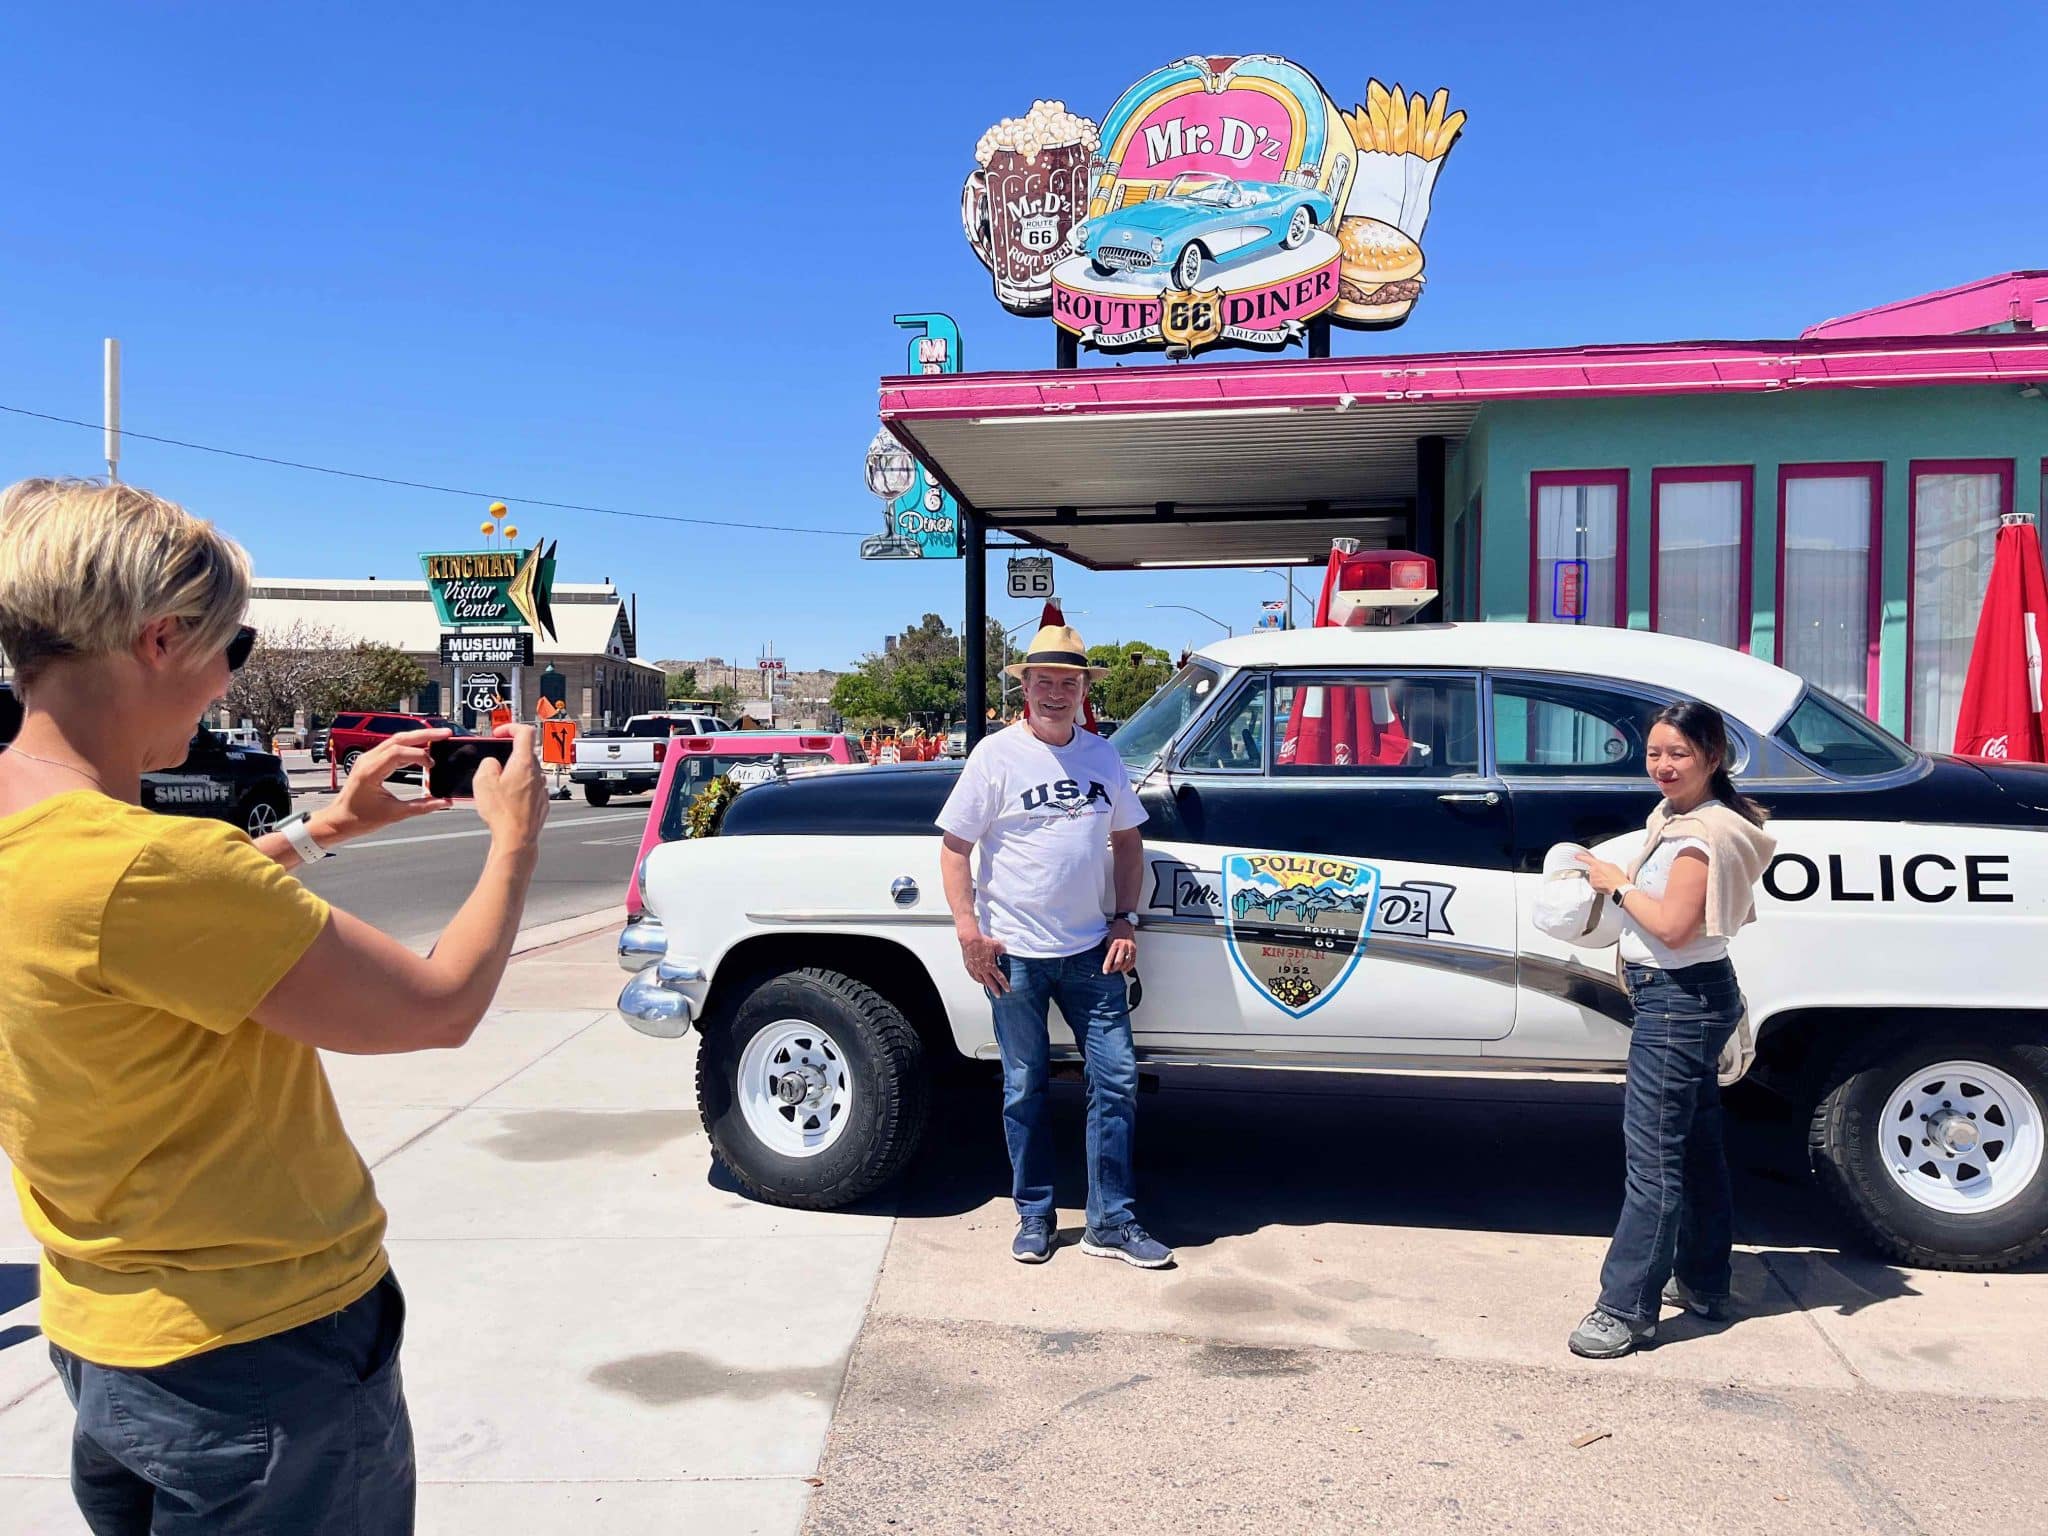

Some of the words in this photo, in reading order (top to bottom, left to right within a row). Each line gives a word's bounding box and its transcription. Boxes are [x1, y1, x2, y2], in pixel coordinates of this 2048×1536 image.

[1142, 116, 1213, 168] Mr.
[1216, 117, 1282, 161] D'z
[1007, 195, 1042, 222] Mr.
[1026, 220, 1053, 228] ROUTE
[1029, 230, 1052, 245] 66
[1008, 245, 1040, 267] ROOT
[1043, 240, 1073, 265] BEER
[1056, 288, 1158, 328] ROUTE
[1170, 302, 1211, 331] 66
[1230, 270, 1332, 325] DINER
[1096, 325, 1155, 345] KINGMAN
[1226, 327, 1285, 343] ARIZONA
[898, 510, 954, 534] Diner
[428, 553, 516, 579] KINGMAN
[443, 580, 496, 600] Visitor
[1012, 574, 1048, 591] 66
[453, 599, 505, 617] Center
[448, 637, 517, 651] MUSEUM
[451, 652, 460, 662] &
[462, 652, 484, 662] GIFT
[485, 651, 514, 662] SHOP
[760, 661, 783, 669] GAS
[474, 694, 493, 708] 66
[155, 785, 230, 802] SHERIFF
[1020, 779, 1112, 811] USA
[1249, 855, 1359, 887] POLICE
[1761, 852, 2015, 904] OLICE
[1179, 880, 1223, 908] Mr.
[1380, 894, 1422, 926] D'z
[1304, 925, 1346, 936] ROUTE
[1315, 936, 1335, 949] 66
[1261, 946, 1326, 960] KINGMAN
[1278, 965, 1311, 975] 1952
